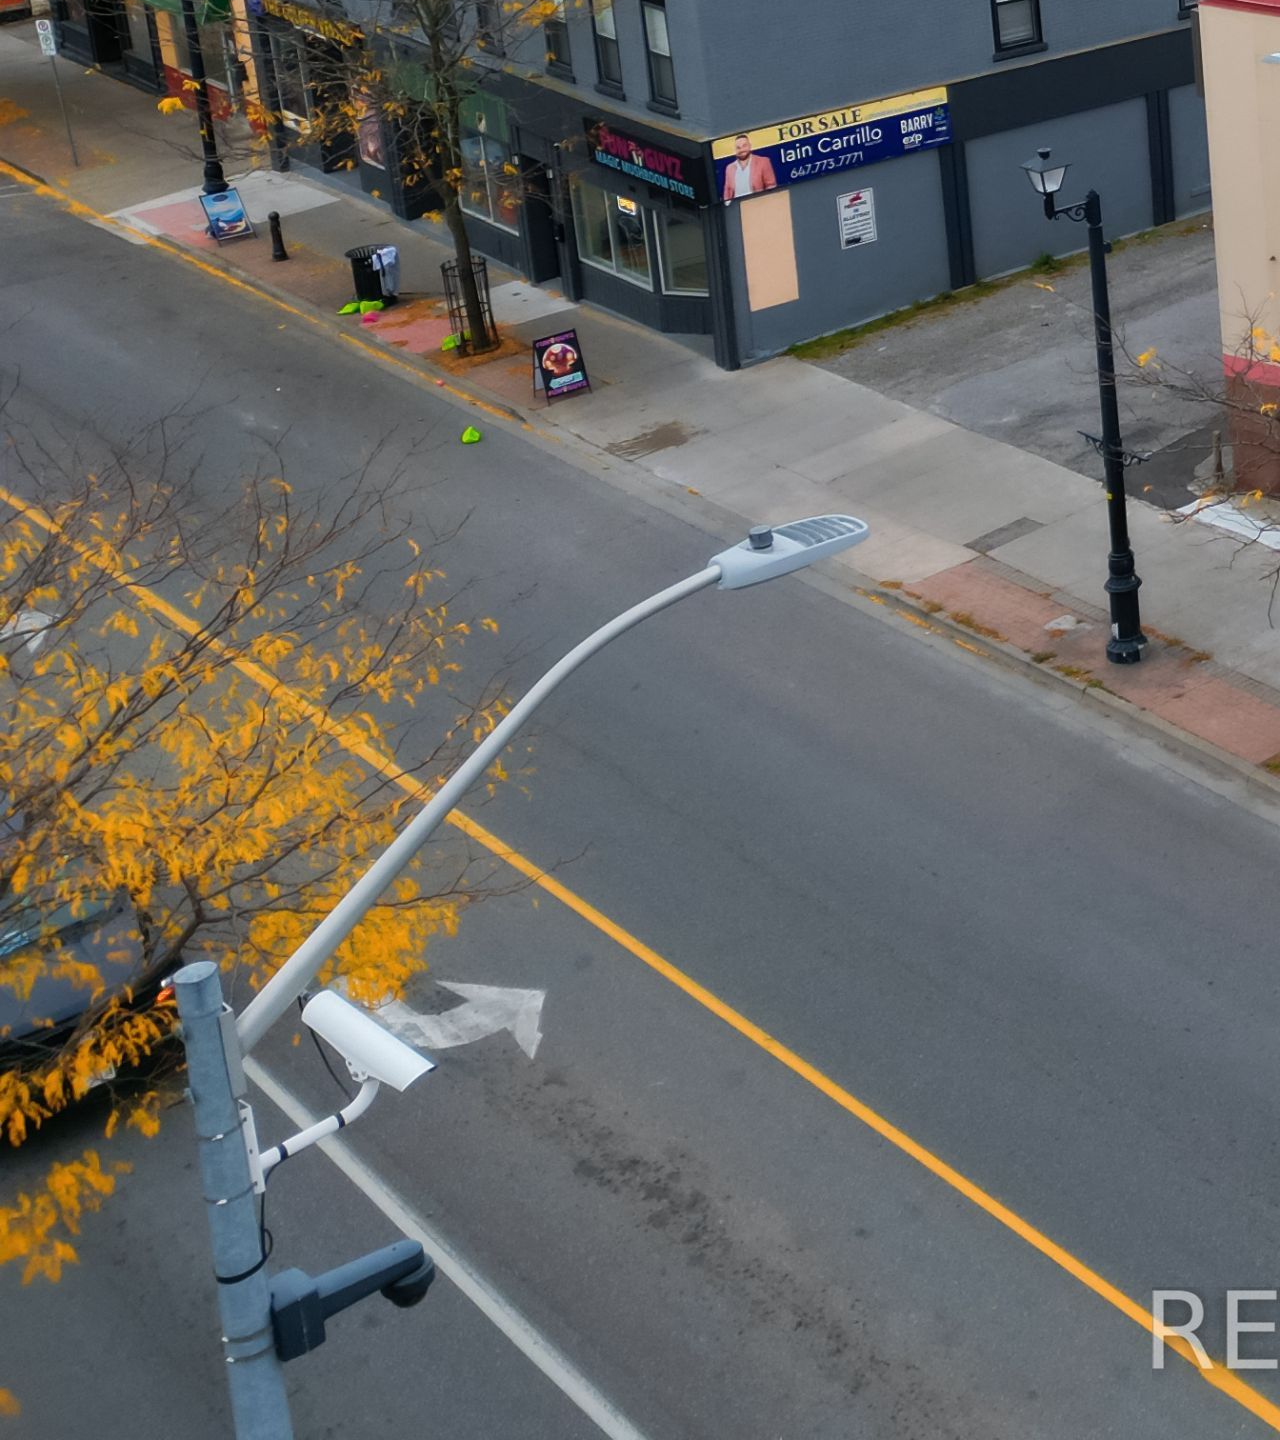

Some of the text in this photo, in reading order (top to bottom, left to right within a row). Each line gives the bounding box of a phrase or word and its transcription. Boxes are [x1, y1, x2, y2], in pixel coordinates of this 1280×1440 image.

[778, 120, 814, 141] FOR
[818, 108, 863, 131] SALE
[900, 113, 933, 134] BARRY
[780, 125, 882, 163] Iain Carrillo
[621, 159, 669, 189] MUSHROOM
[669, 179, 695, 199] STORE
[644, 147, 684, 180] GUYZ
[790, 151, 864, 179] 647.773.7771
